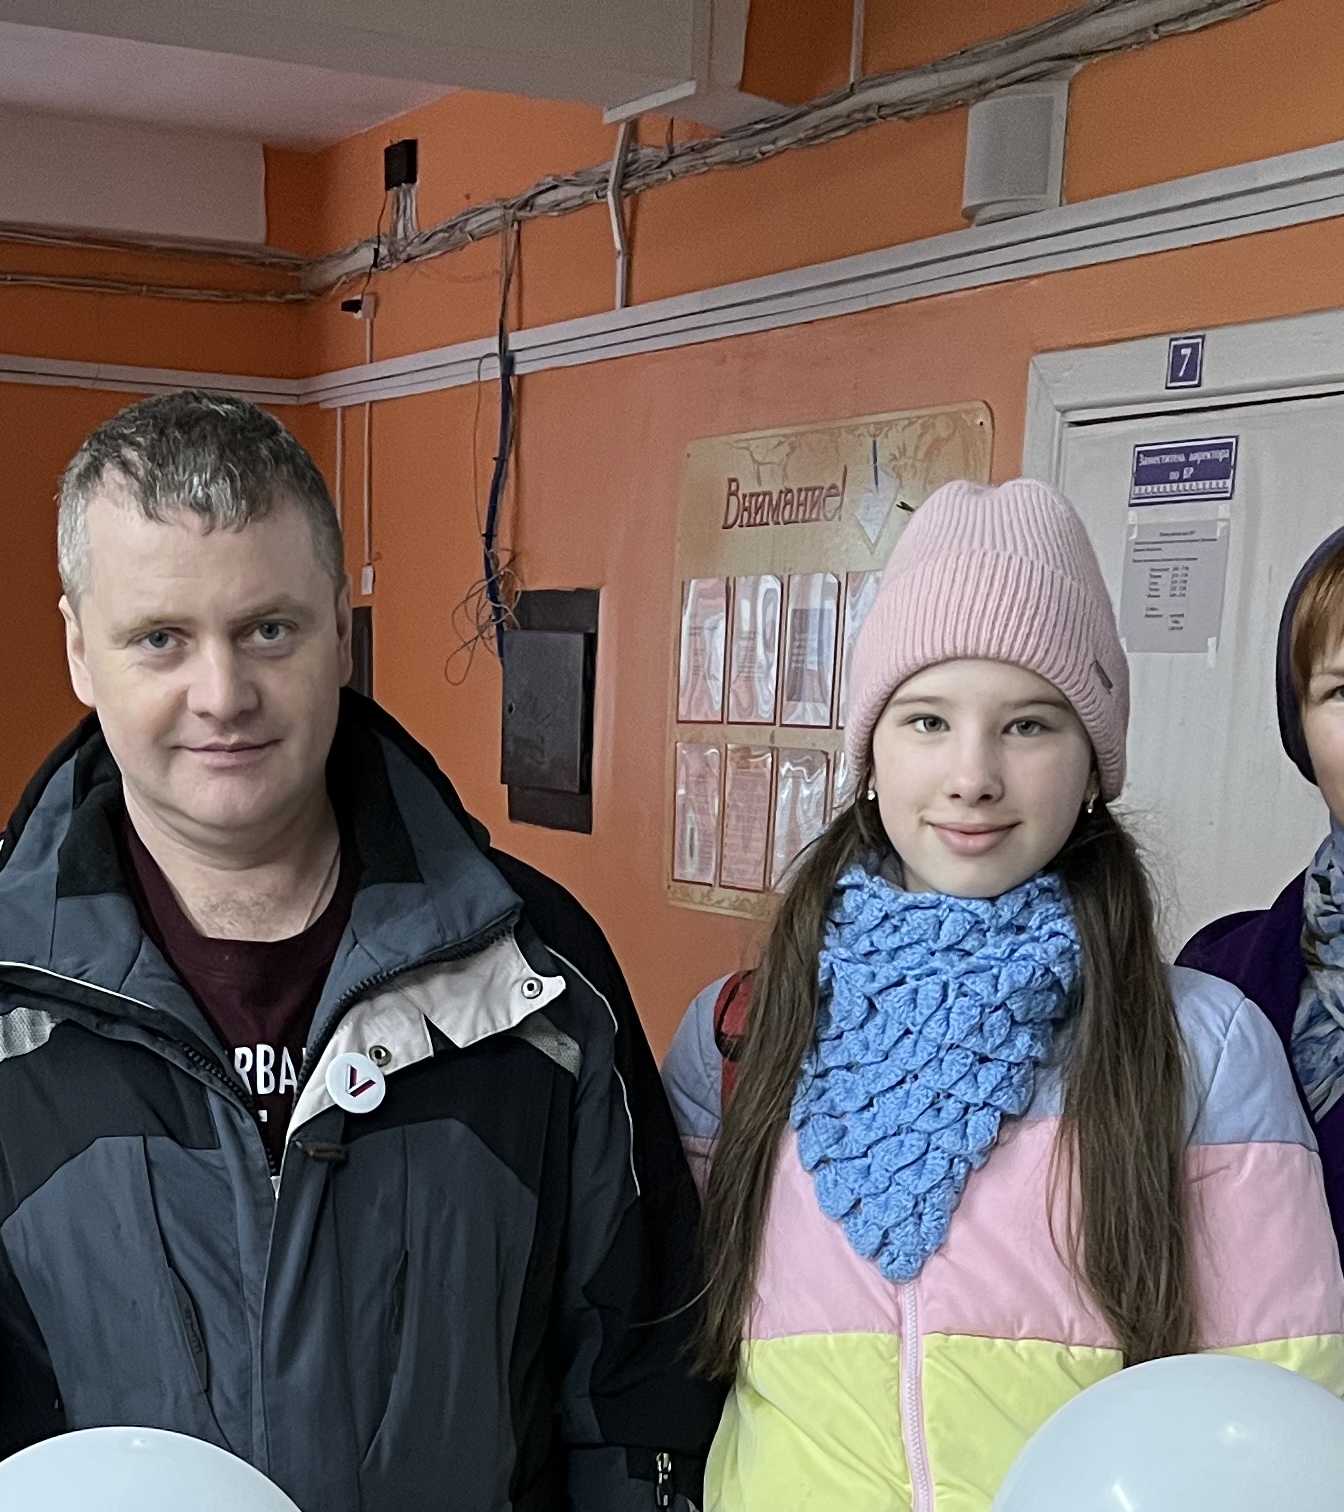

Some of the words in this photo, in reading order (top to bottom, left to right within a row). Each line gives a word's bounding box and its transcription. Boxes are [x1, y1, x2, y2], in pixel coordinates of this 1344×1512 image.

[1178, 347, 1192, 378] 7
[722, 464, 848, 530] Внимание!
[234, 1043, 306, 1096] RBA
